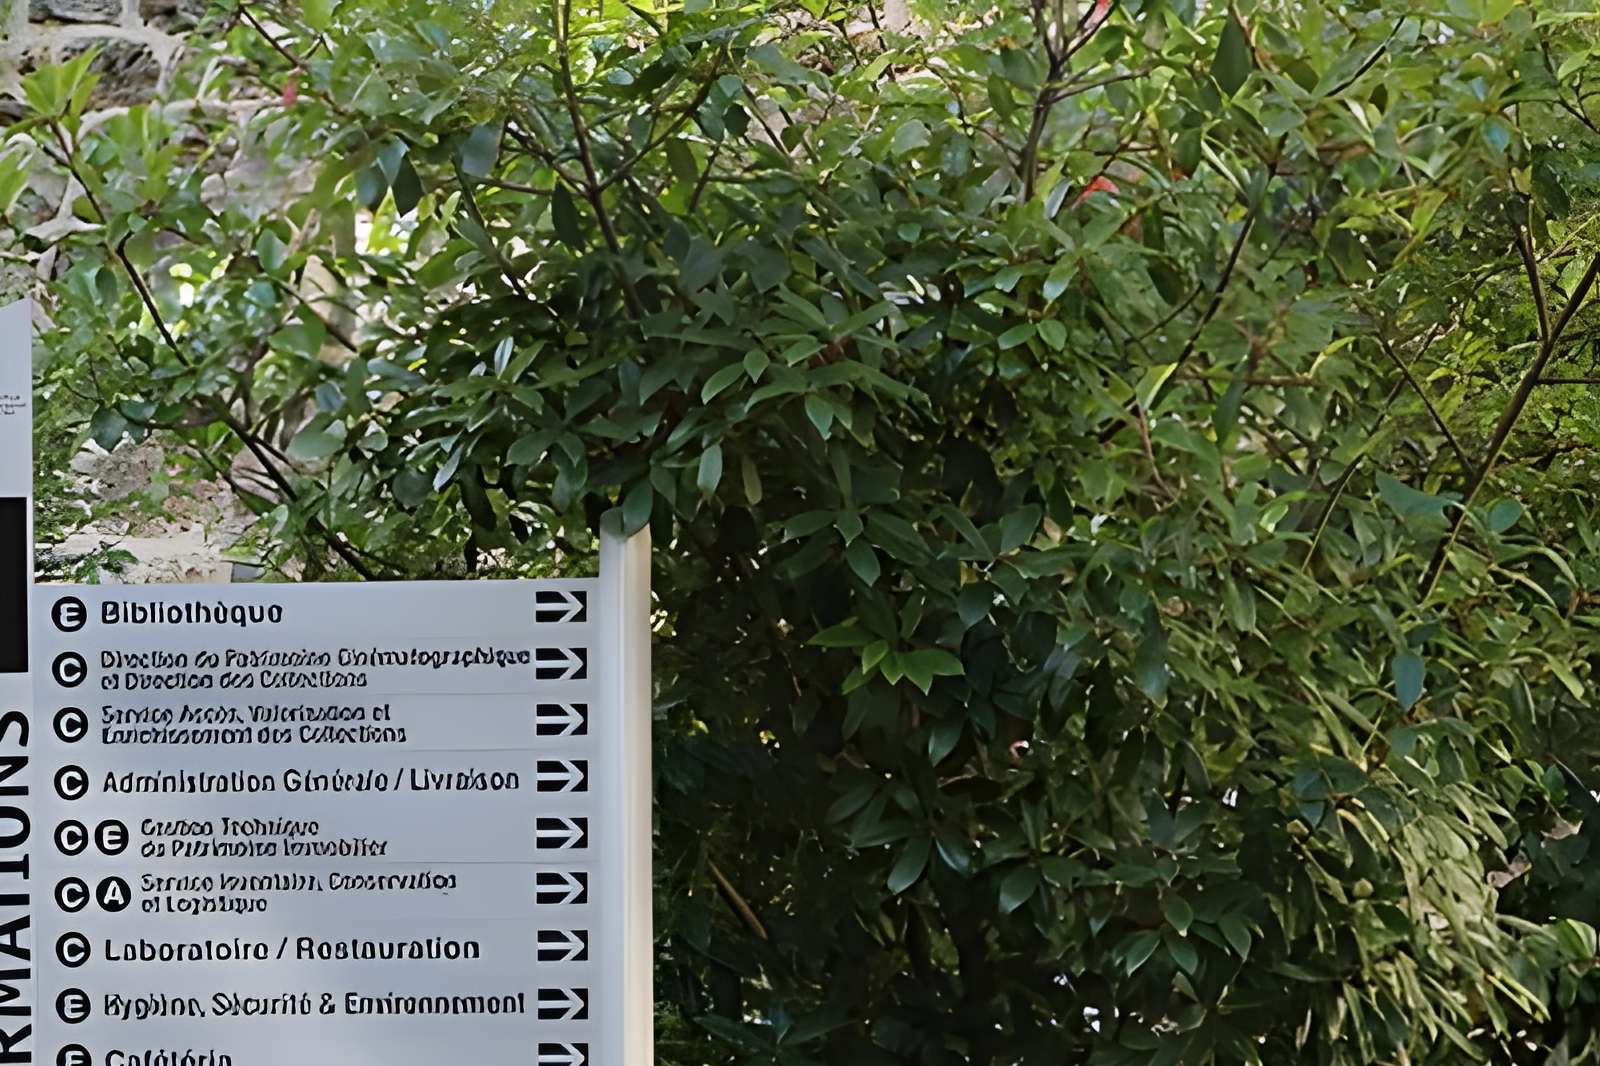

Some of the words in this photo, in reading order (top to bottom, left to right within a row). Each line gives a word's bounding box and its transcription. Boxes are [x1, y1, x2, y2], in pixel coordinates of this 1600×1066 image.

[103, 770, 276, 793] Administration
[105, 938, 268, 961] Laboratoire
[297, 937, 480, 960] Restauration
[319, 993, 335, 1015] &
